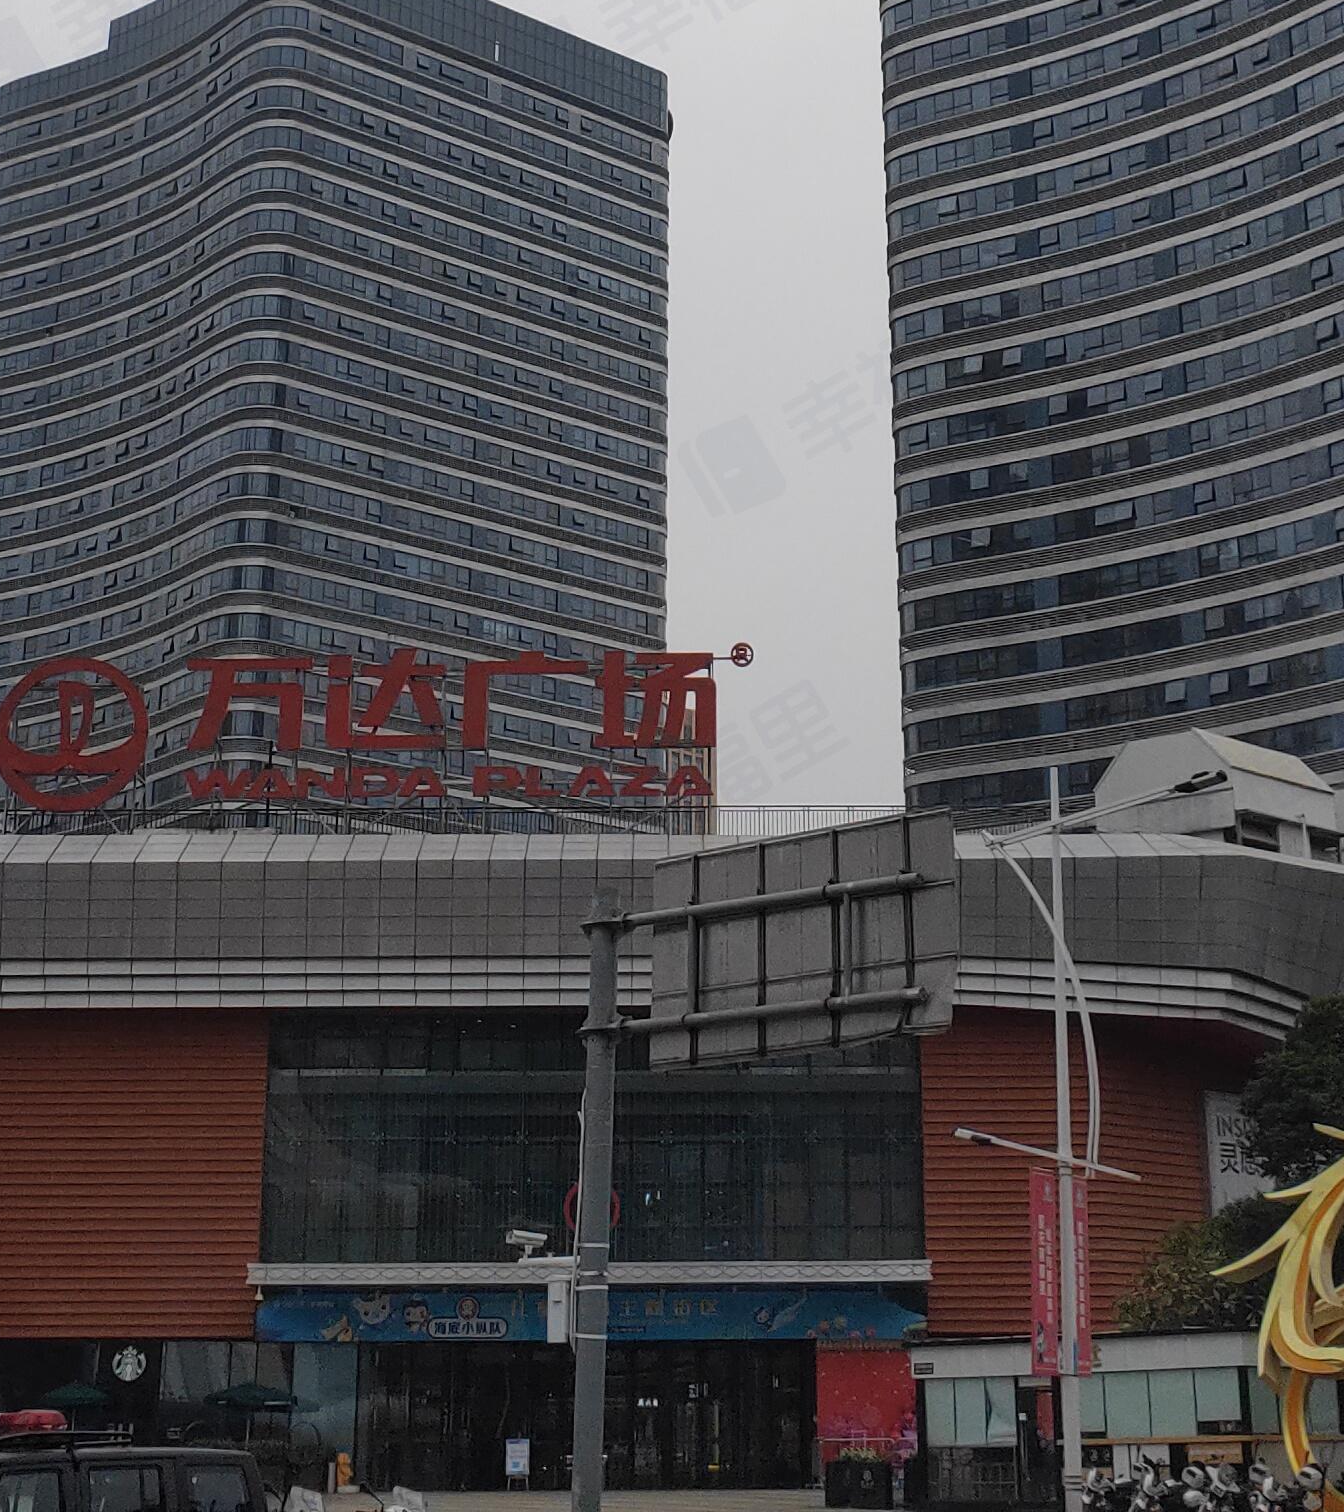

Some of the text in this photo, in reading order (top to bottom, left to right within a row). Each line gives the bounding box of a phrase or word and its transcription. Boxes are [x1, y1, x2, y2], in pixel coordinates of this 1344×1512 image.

[187, 648, 717, 751] 万达广场
[185, 766, 713, 800] WANDA PLAZA
